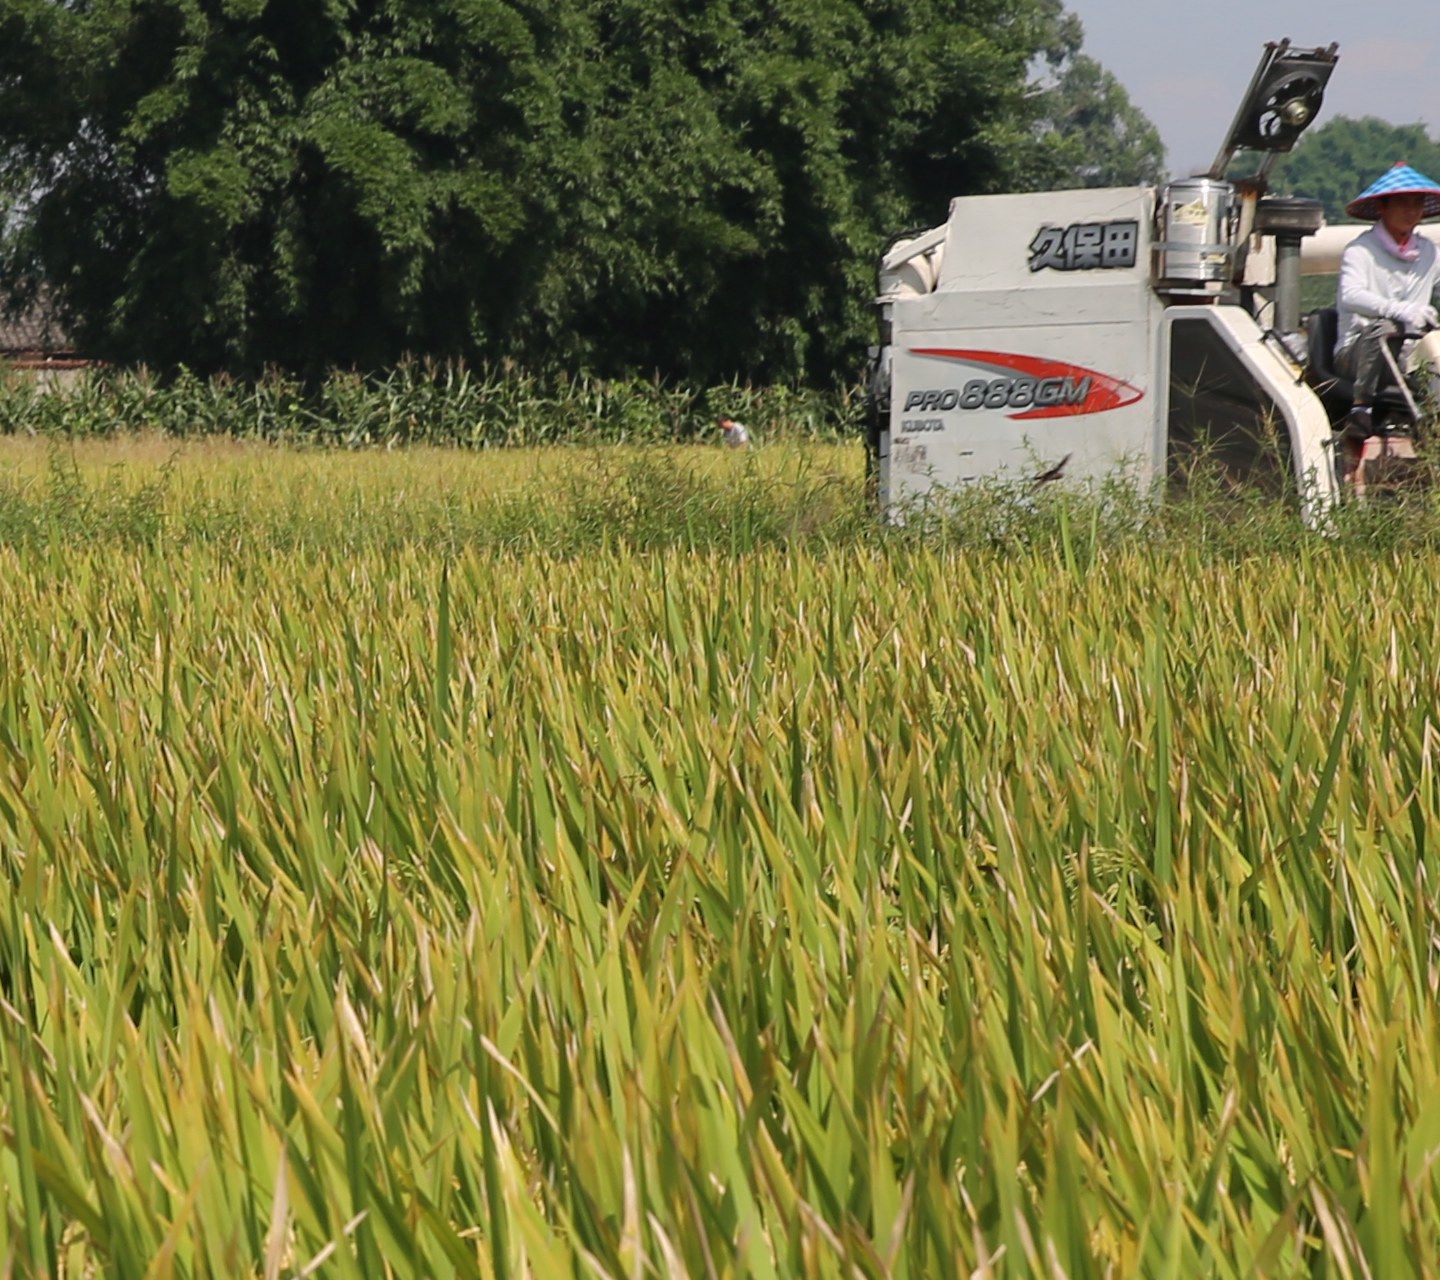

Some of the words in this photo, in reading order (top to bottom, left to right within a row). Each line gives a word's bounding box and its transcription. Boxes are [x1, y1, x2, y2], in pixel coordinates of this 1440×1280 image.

[1027, 220, 1139, 273] 久保田
[903, 376, 1093, 413] PRO888GM
[901, 419, 945, 433] KUBOTA
